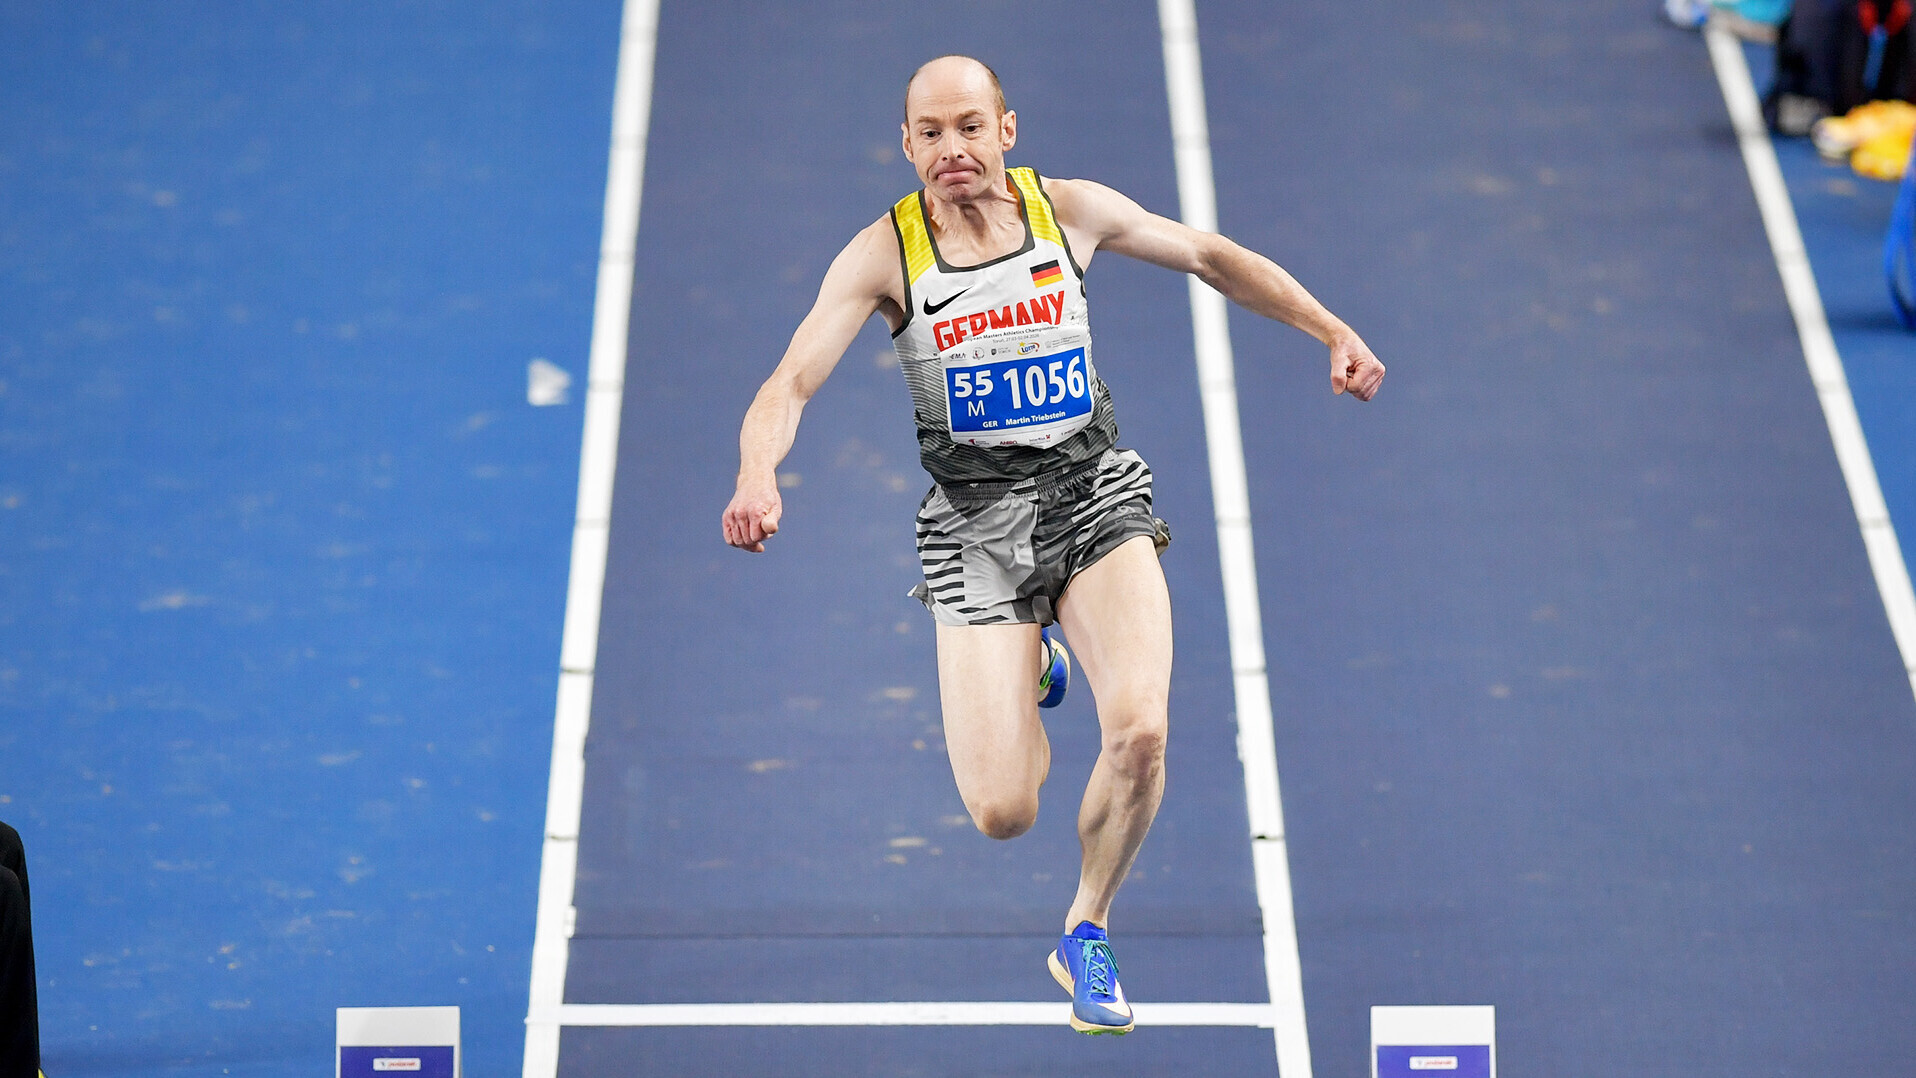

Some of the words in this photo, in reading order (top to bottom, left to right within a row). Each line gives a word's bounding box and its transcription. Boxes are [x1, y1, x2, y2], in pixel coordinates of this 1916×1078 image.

[932, 290, 1065, 352] GERMANY
[1003, 329, 1025, 337] Athletics
[954, 369, 994, 398] 55
[1003, 355, 1085, 410] 1056
[967, 399, 986, 417] M
[982, 420, 998, 428] GER
[1005, 416, 1031, 426] Martin
[1030, 410, 1066, 422] Triebstein
